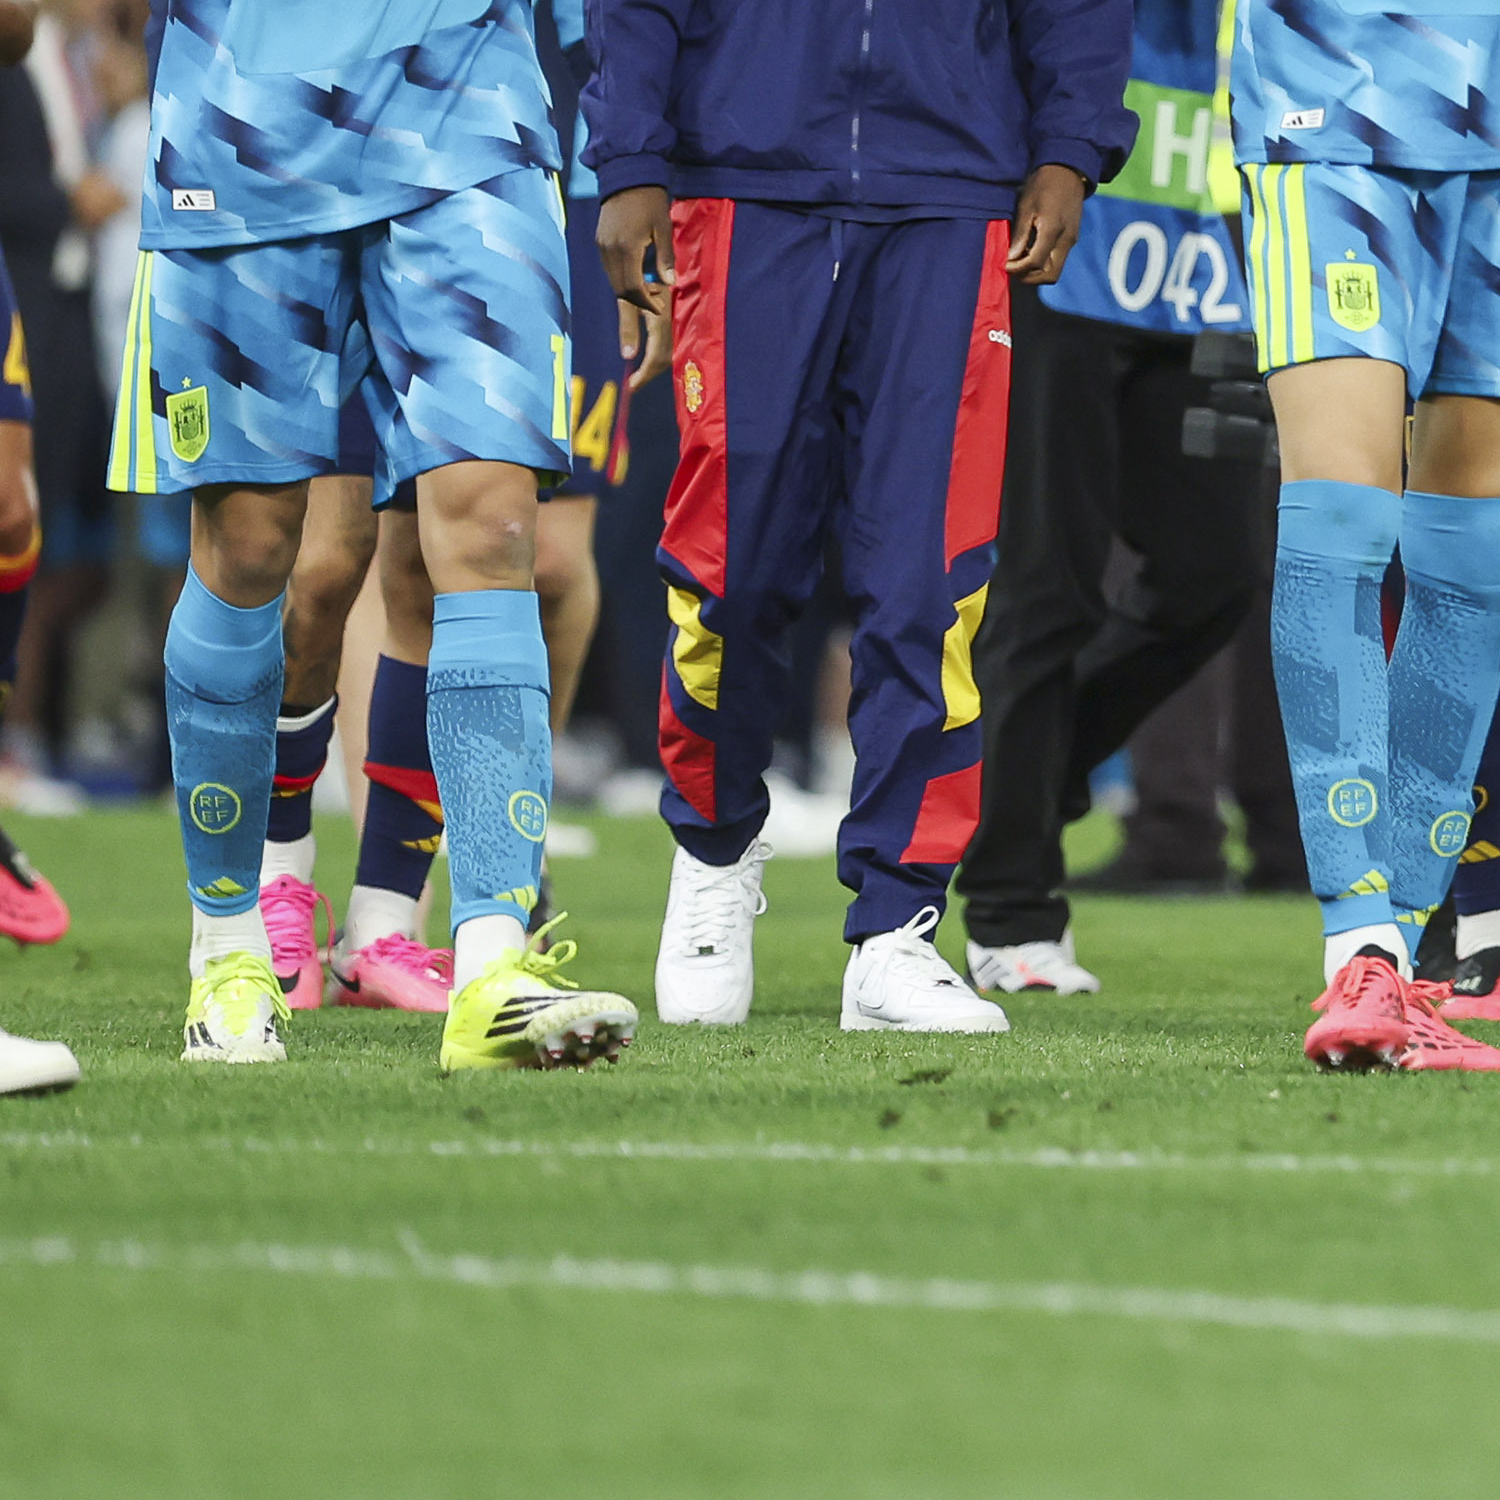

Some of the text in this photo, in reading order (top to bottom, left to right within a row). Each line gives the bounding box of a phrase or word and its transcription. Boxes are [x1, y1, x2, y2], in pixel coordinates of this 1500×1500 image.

[1150, 100, 1212, 195] H
[1108, 219, 1242, 324] 042
[550, 334, 568, 441] 1
[200, 795, 228, 808] RF
[1339, 788, 1366, 802] RF
[201, 809, 229, 823] EF
[1340, 802, 1367, 817] EF
